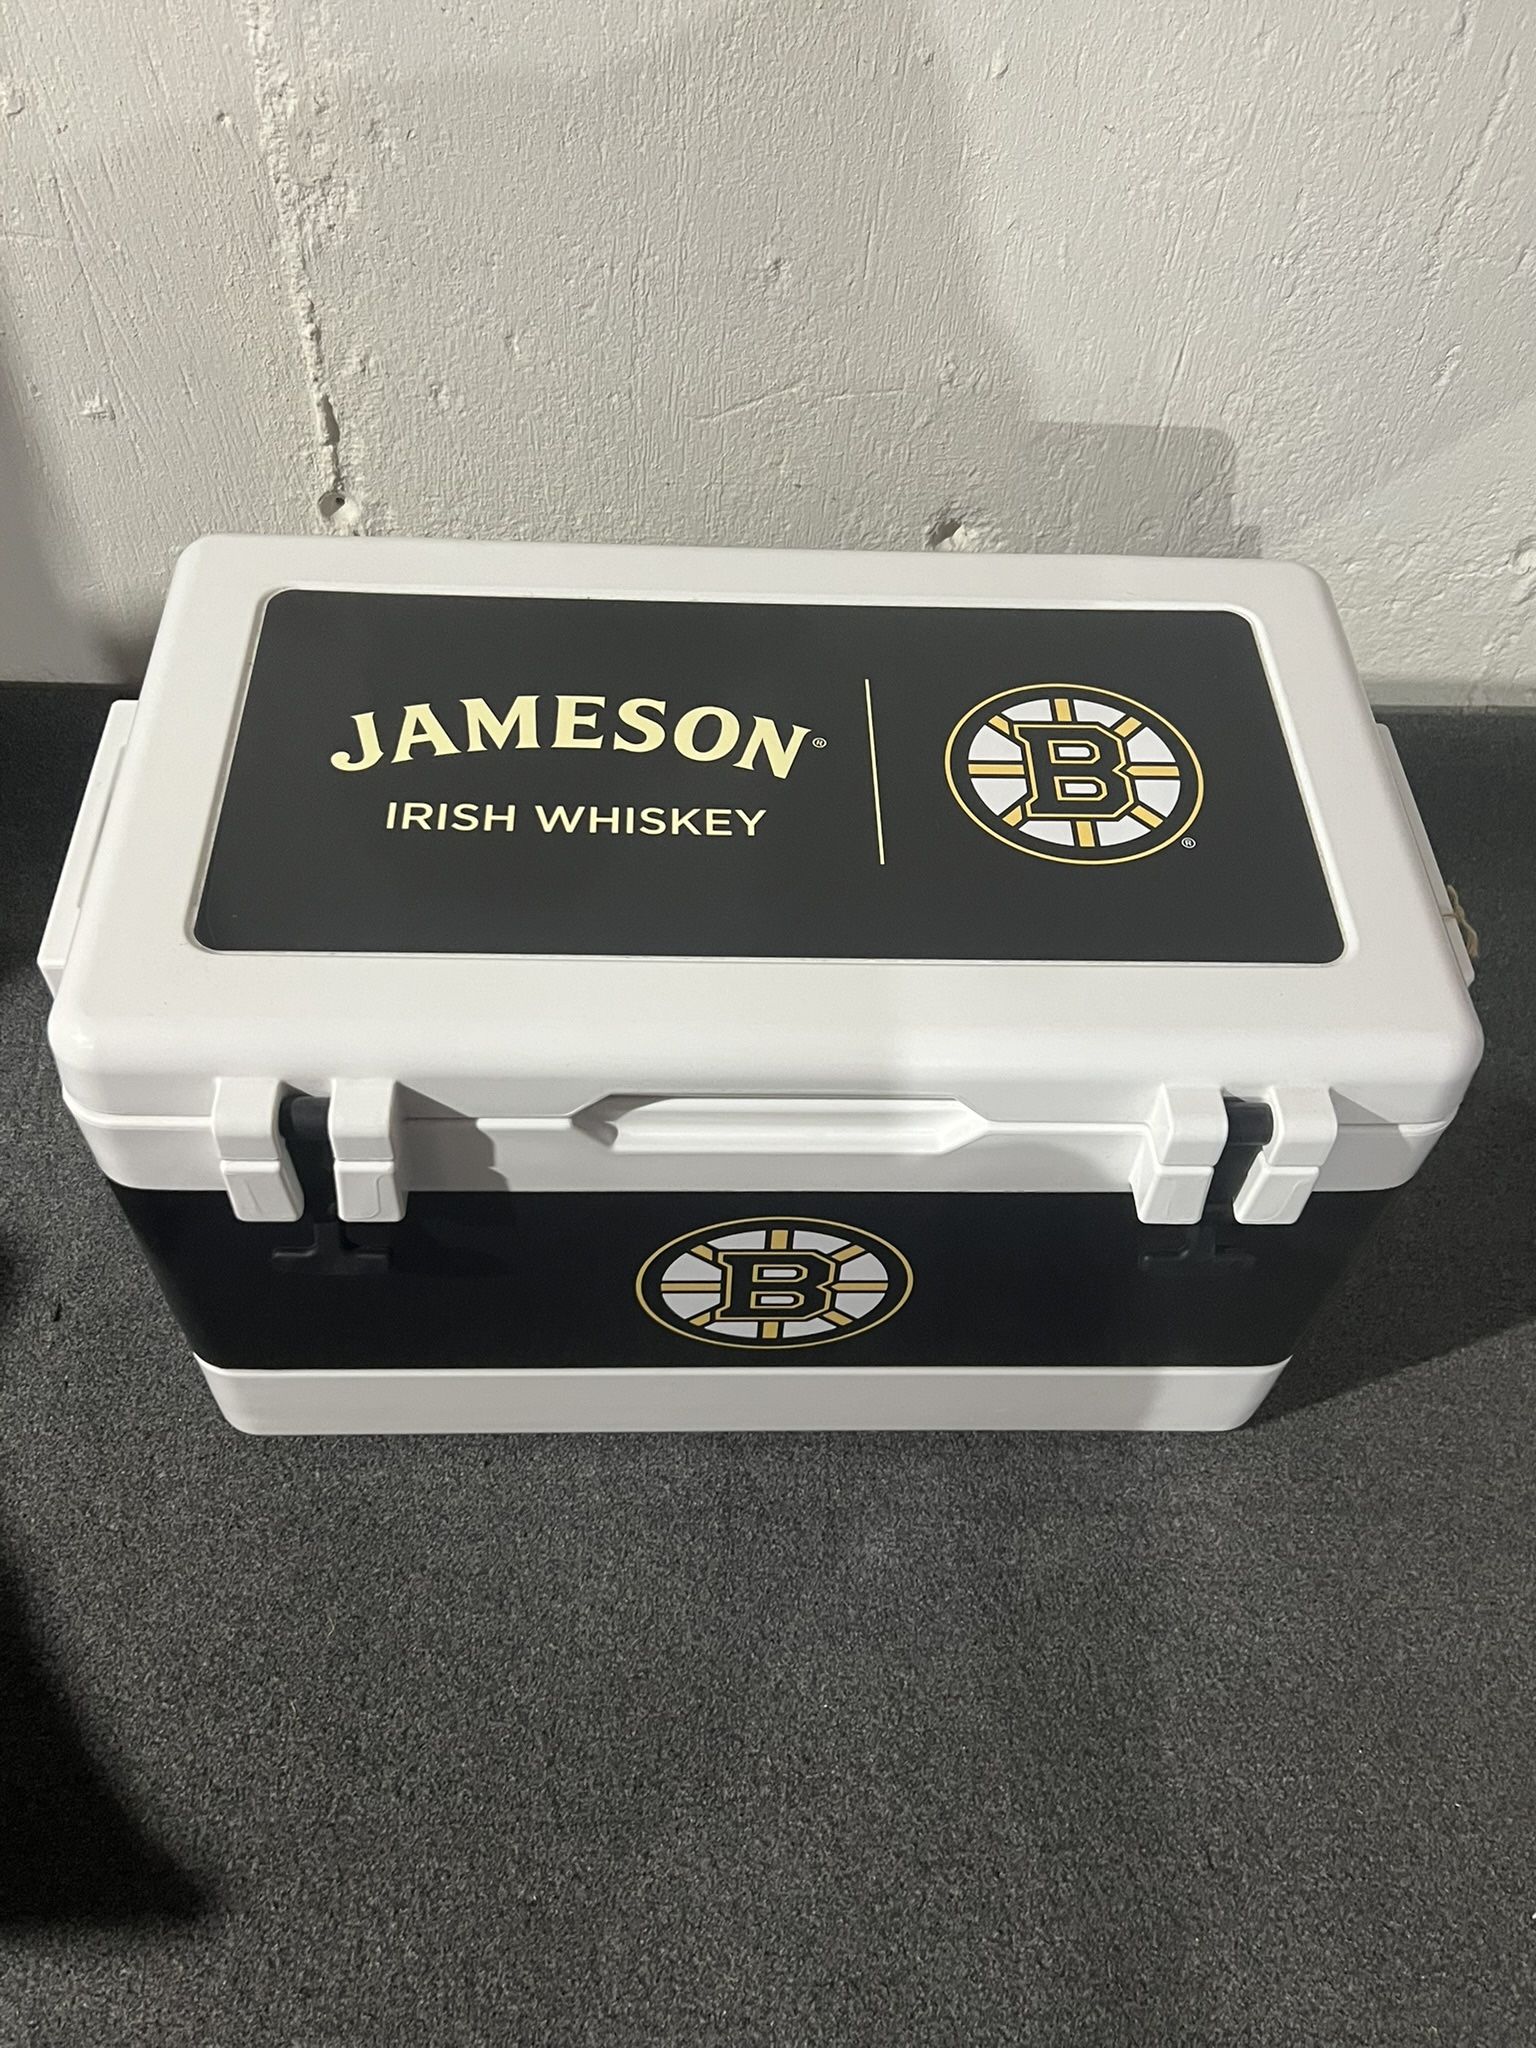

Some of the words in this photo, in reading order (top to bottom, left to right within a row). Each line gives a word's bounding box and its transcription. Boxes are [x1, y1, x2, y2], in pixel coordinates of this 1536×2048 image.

[1012, 723, 1135, 819] B
[386, 801, 516, 833] IRISH
[534, 804, 768, 837] WHISKEY
[715, 1250, 837, 1321] B
